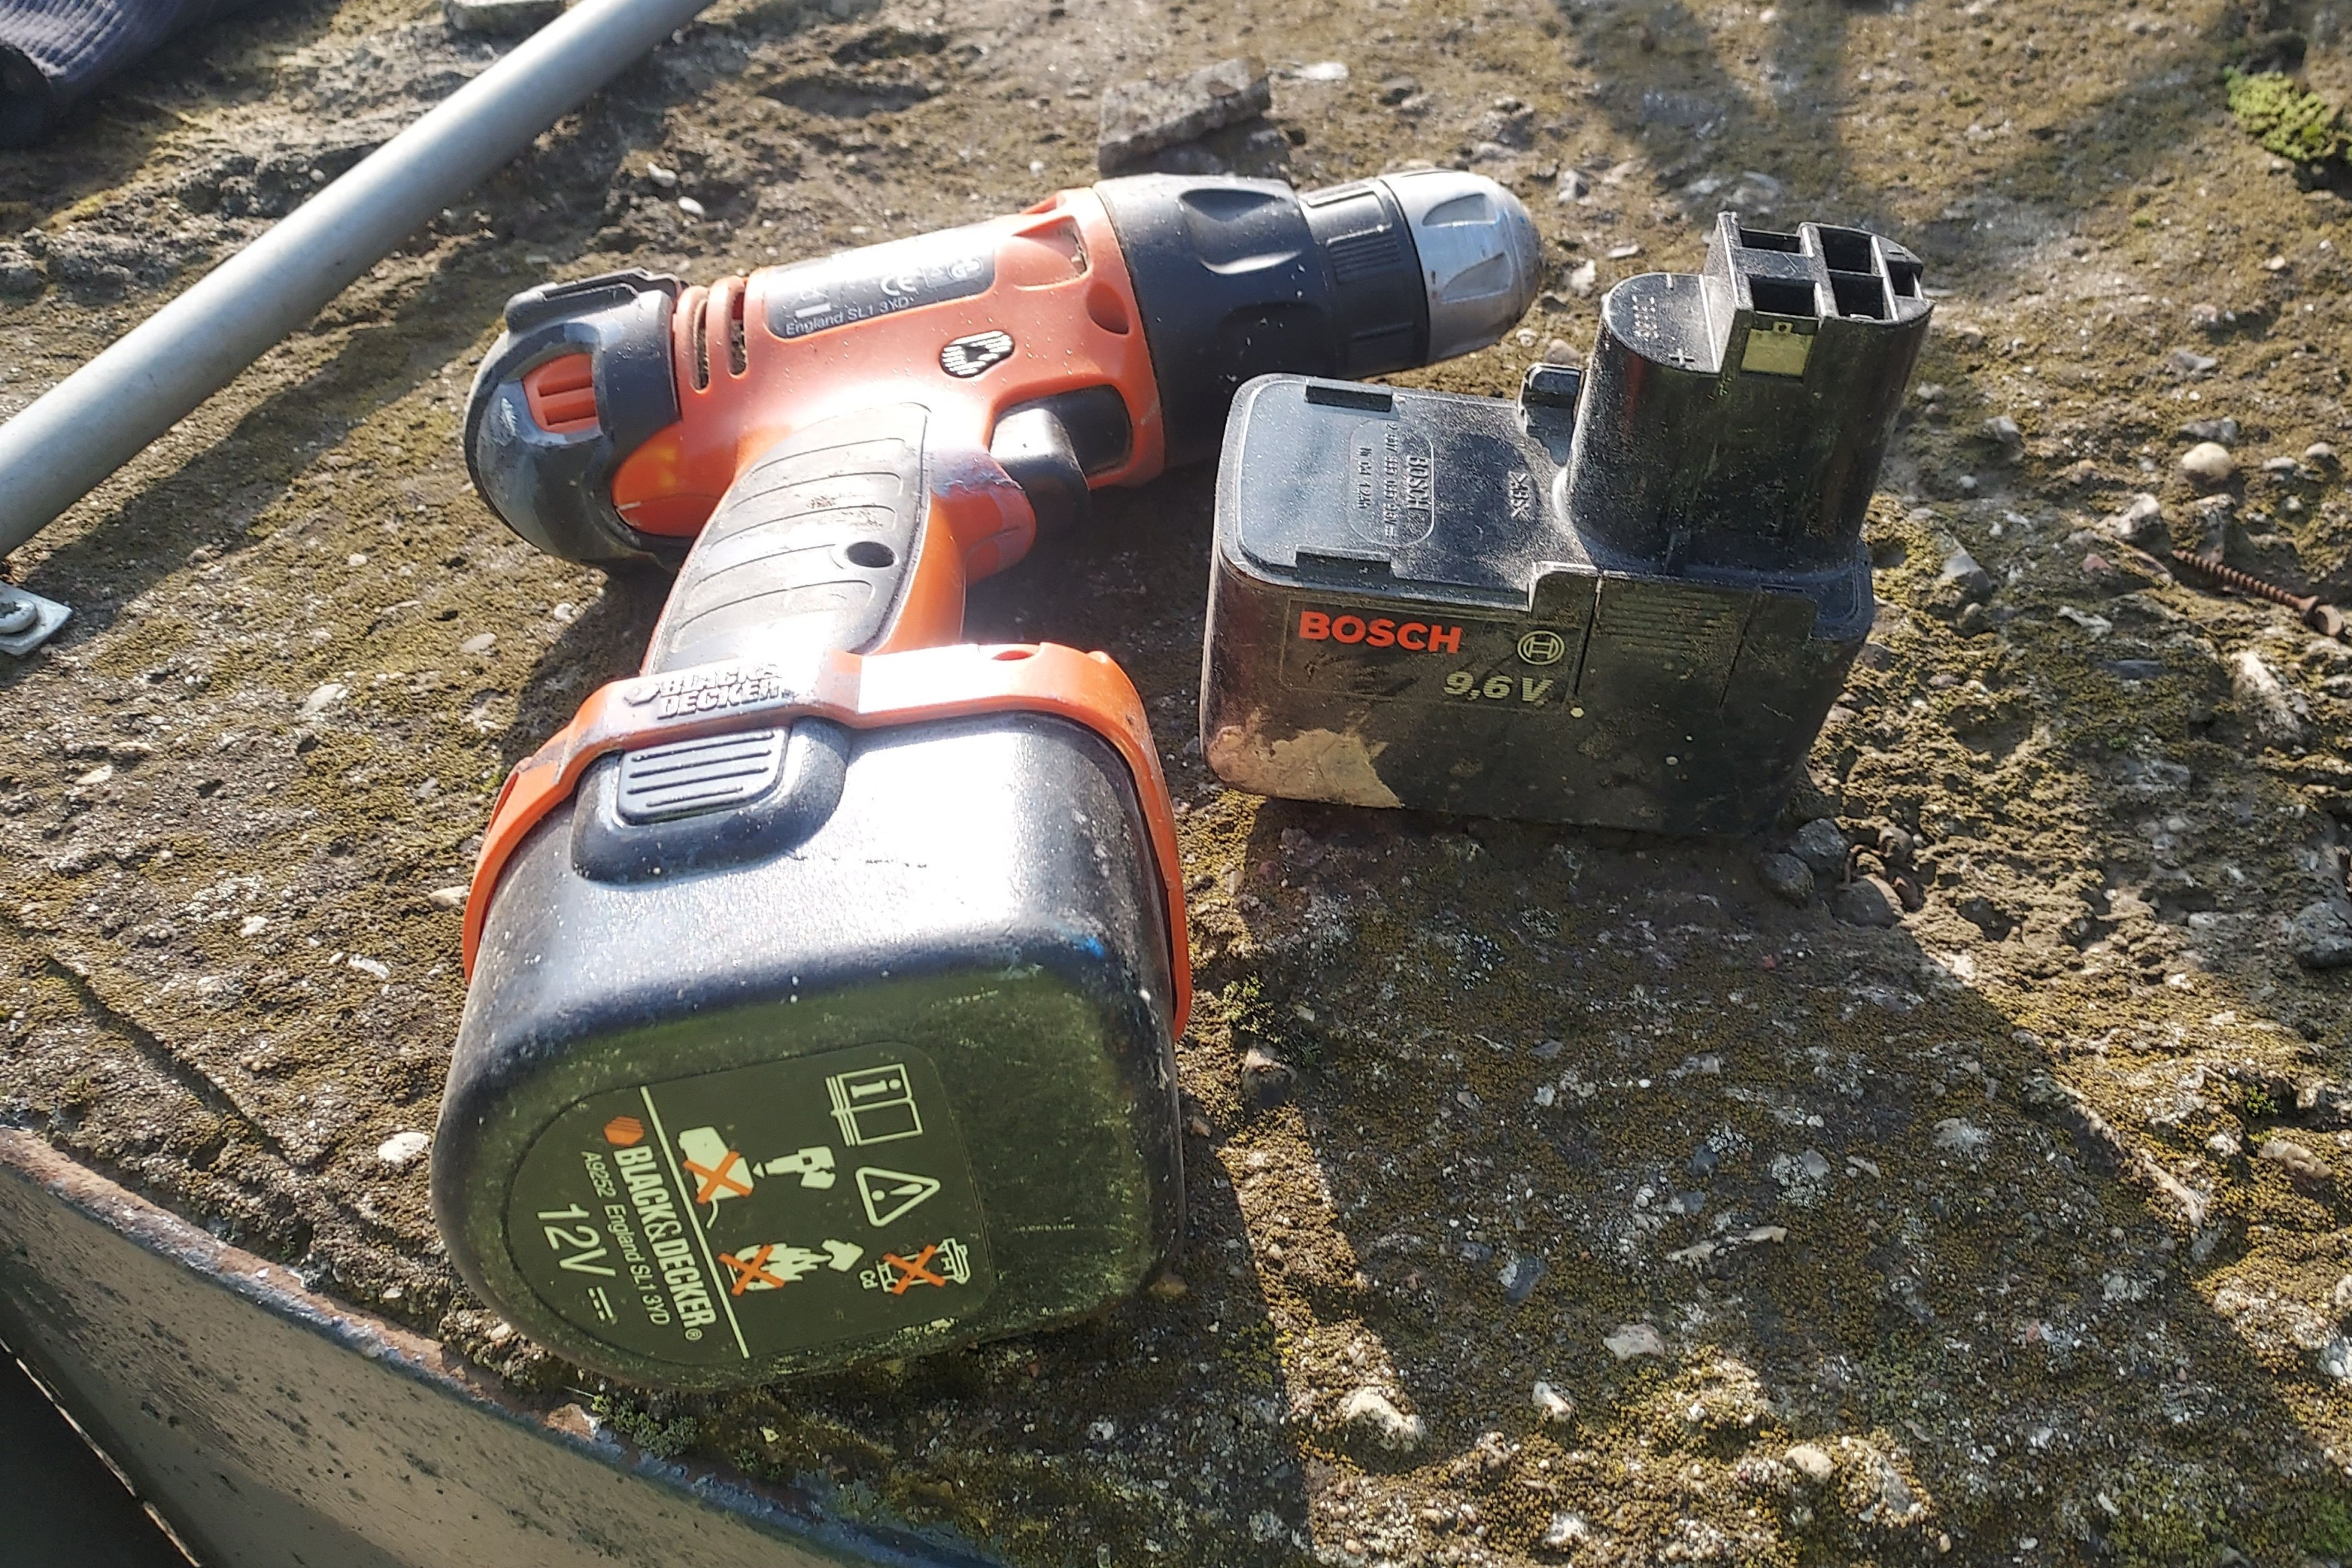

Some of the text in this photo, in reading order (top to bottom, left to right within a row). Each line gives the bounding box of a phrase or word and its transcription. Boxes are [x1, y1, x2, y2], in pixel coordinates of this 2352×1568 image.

[786, 296, 909, 336] England SL1 3YD
[1406, 455, 1431, 511] BOSCH
[1298, 611, 1462, 654] BOSCH
[657, 678, 781, 720] DECKER
[1521, 677, 1554, 703] V
[538, 1203, 616, 1277] 12V
[580, 1151, 670, 1326] A9252 England SL1 3YD
[859, 1269, 878, 1290] Cd
